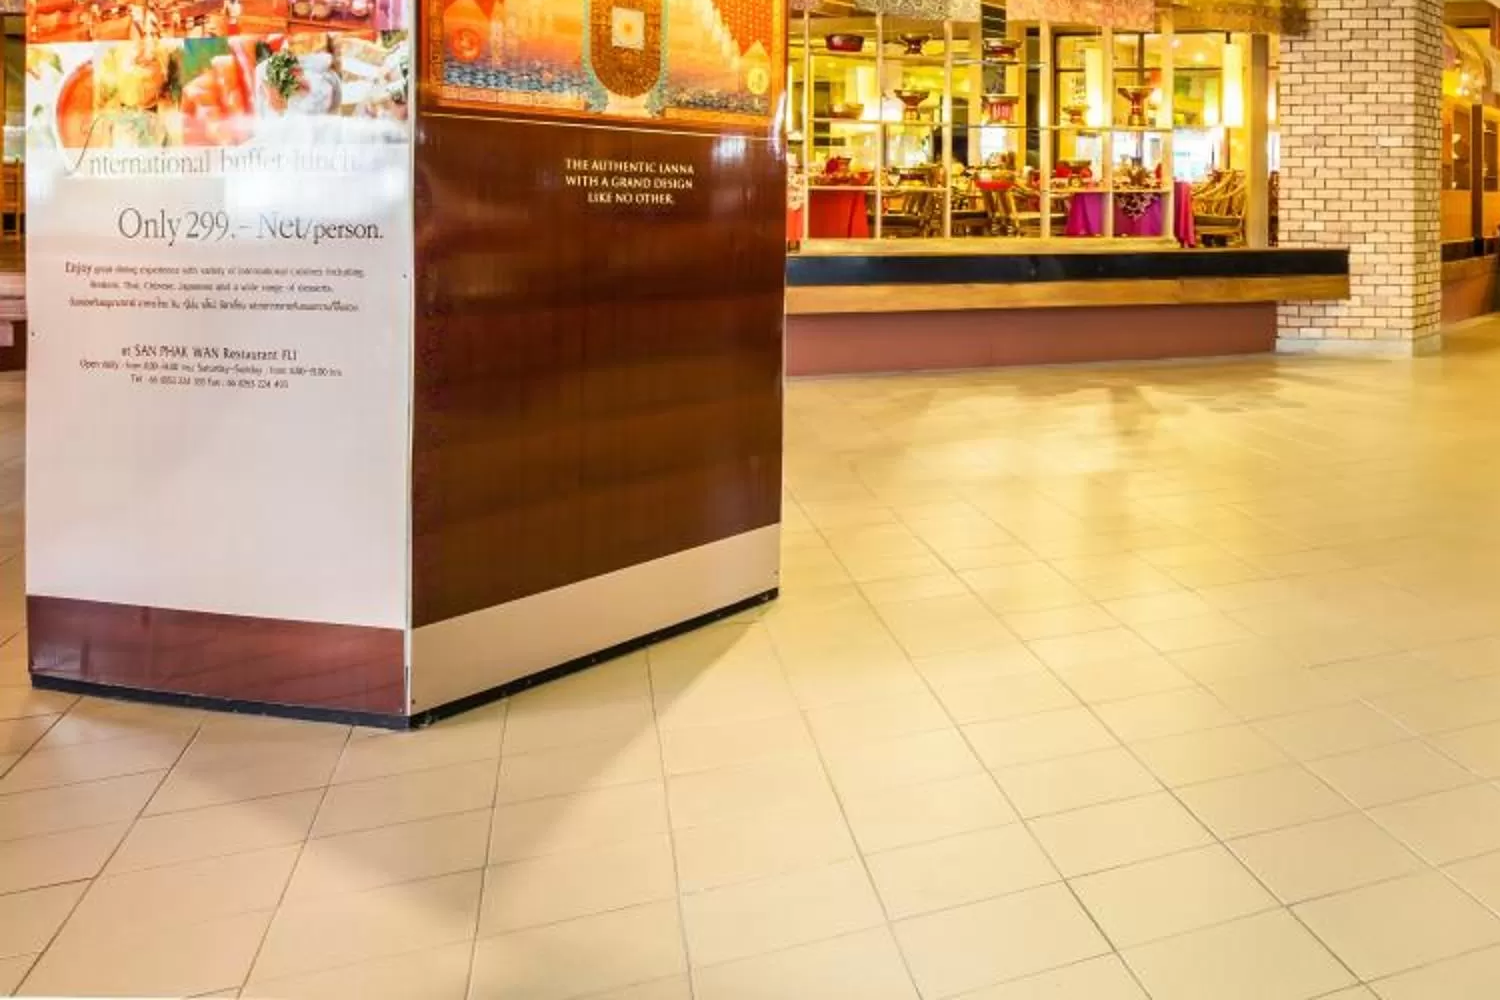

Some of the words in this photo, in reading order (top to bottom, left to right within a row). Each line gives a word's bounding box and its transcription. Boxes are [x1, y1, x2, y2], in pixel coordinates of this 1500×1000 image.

[566, 157, 589, 171] THE
[591, 159, 657, 173] AUTHENTIC
[659, 162, 694, 175] LANNA
[565, 175, 599, 187] WITH
[601, 176, 609, 187] A
[611, 176, 652, 189] GRAND
[653, 178, 693, 190] DESIGN
[587, 191, 612, 203] LIKE
[615, 193, 633, 204] NO
[118, 207, 181, 247] Only
[65, 261, 92, 276] Enjoy
[135, 344, 157, 357] SAN
[191, 346, 219, 359] WAN
[223, 347, 279, 361] Restaurant
